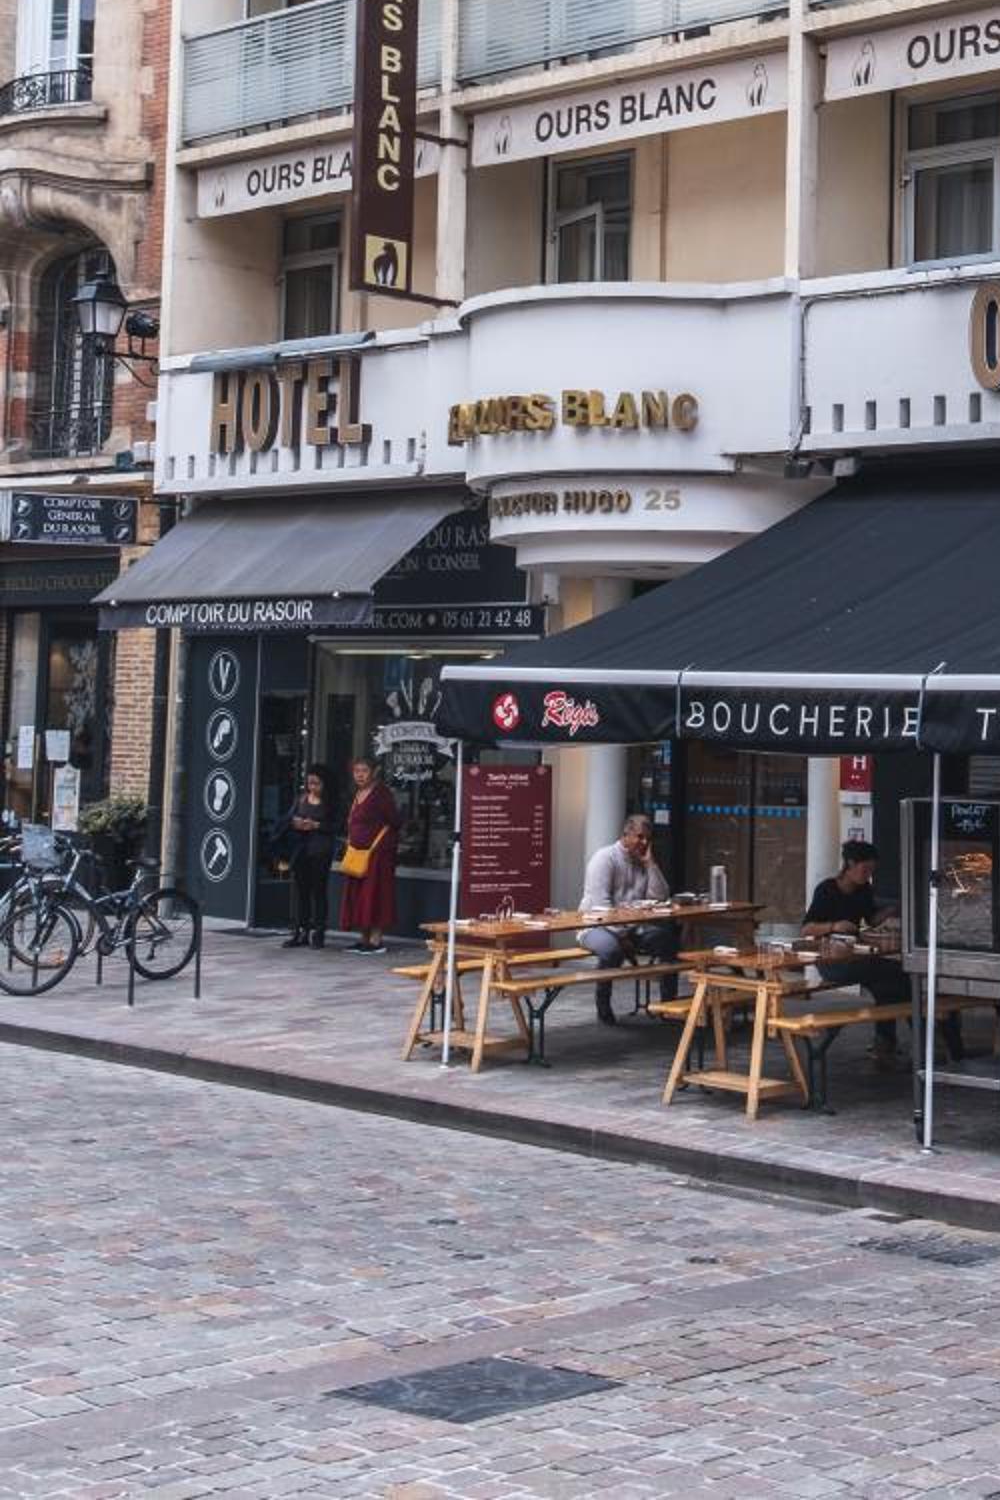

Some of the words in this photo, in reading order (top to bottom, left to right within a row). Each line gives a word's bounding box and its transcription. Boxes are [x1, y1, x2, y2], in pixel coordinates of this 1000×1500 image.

[376, 45, 402, 191] BLANC
[535, 98, 611, 144] OURS
[619, 76, 718, 126] BLANC
[247, 161, 305, 196] OURS
[312, 152, 352, 182] BLA
[210, 354, 372, 452] HOTEL
[561, 389, 699, 431] BLANC
[644, 489, 681, 510] 25
[455, 525, 489, 547] RAS
[145, 602, 224, 624] COMPTOIR
[227, 602, 250, 623] DU
[253, 600, 313, 622] RASOIR
[495, 609, 511, 627] 42
[514, 609, 531, 626] 48
[686, 701, 920, 739] BOUCHERIE
